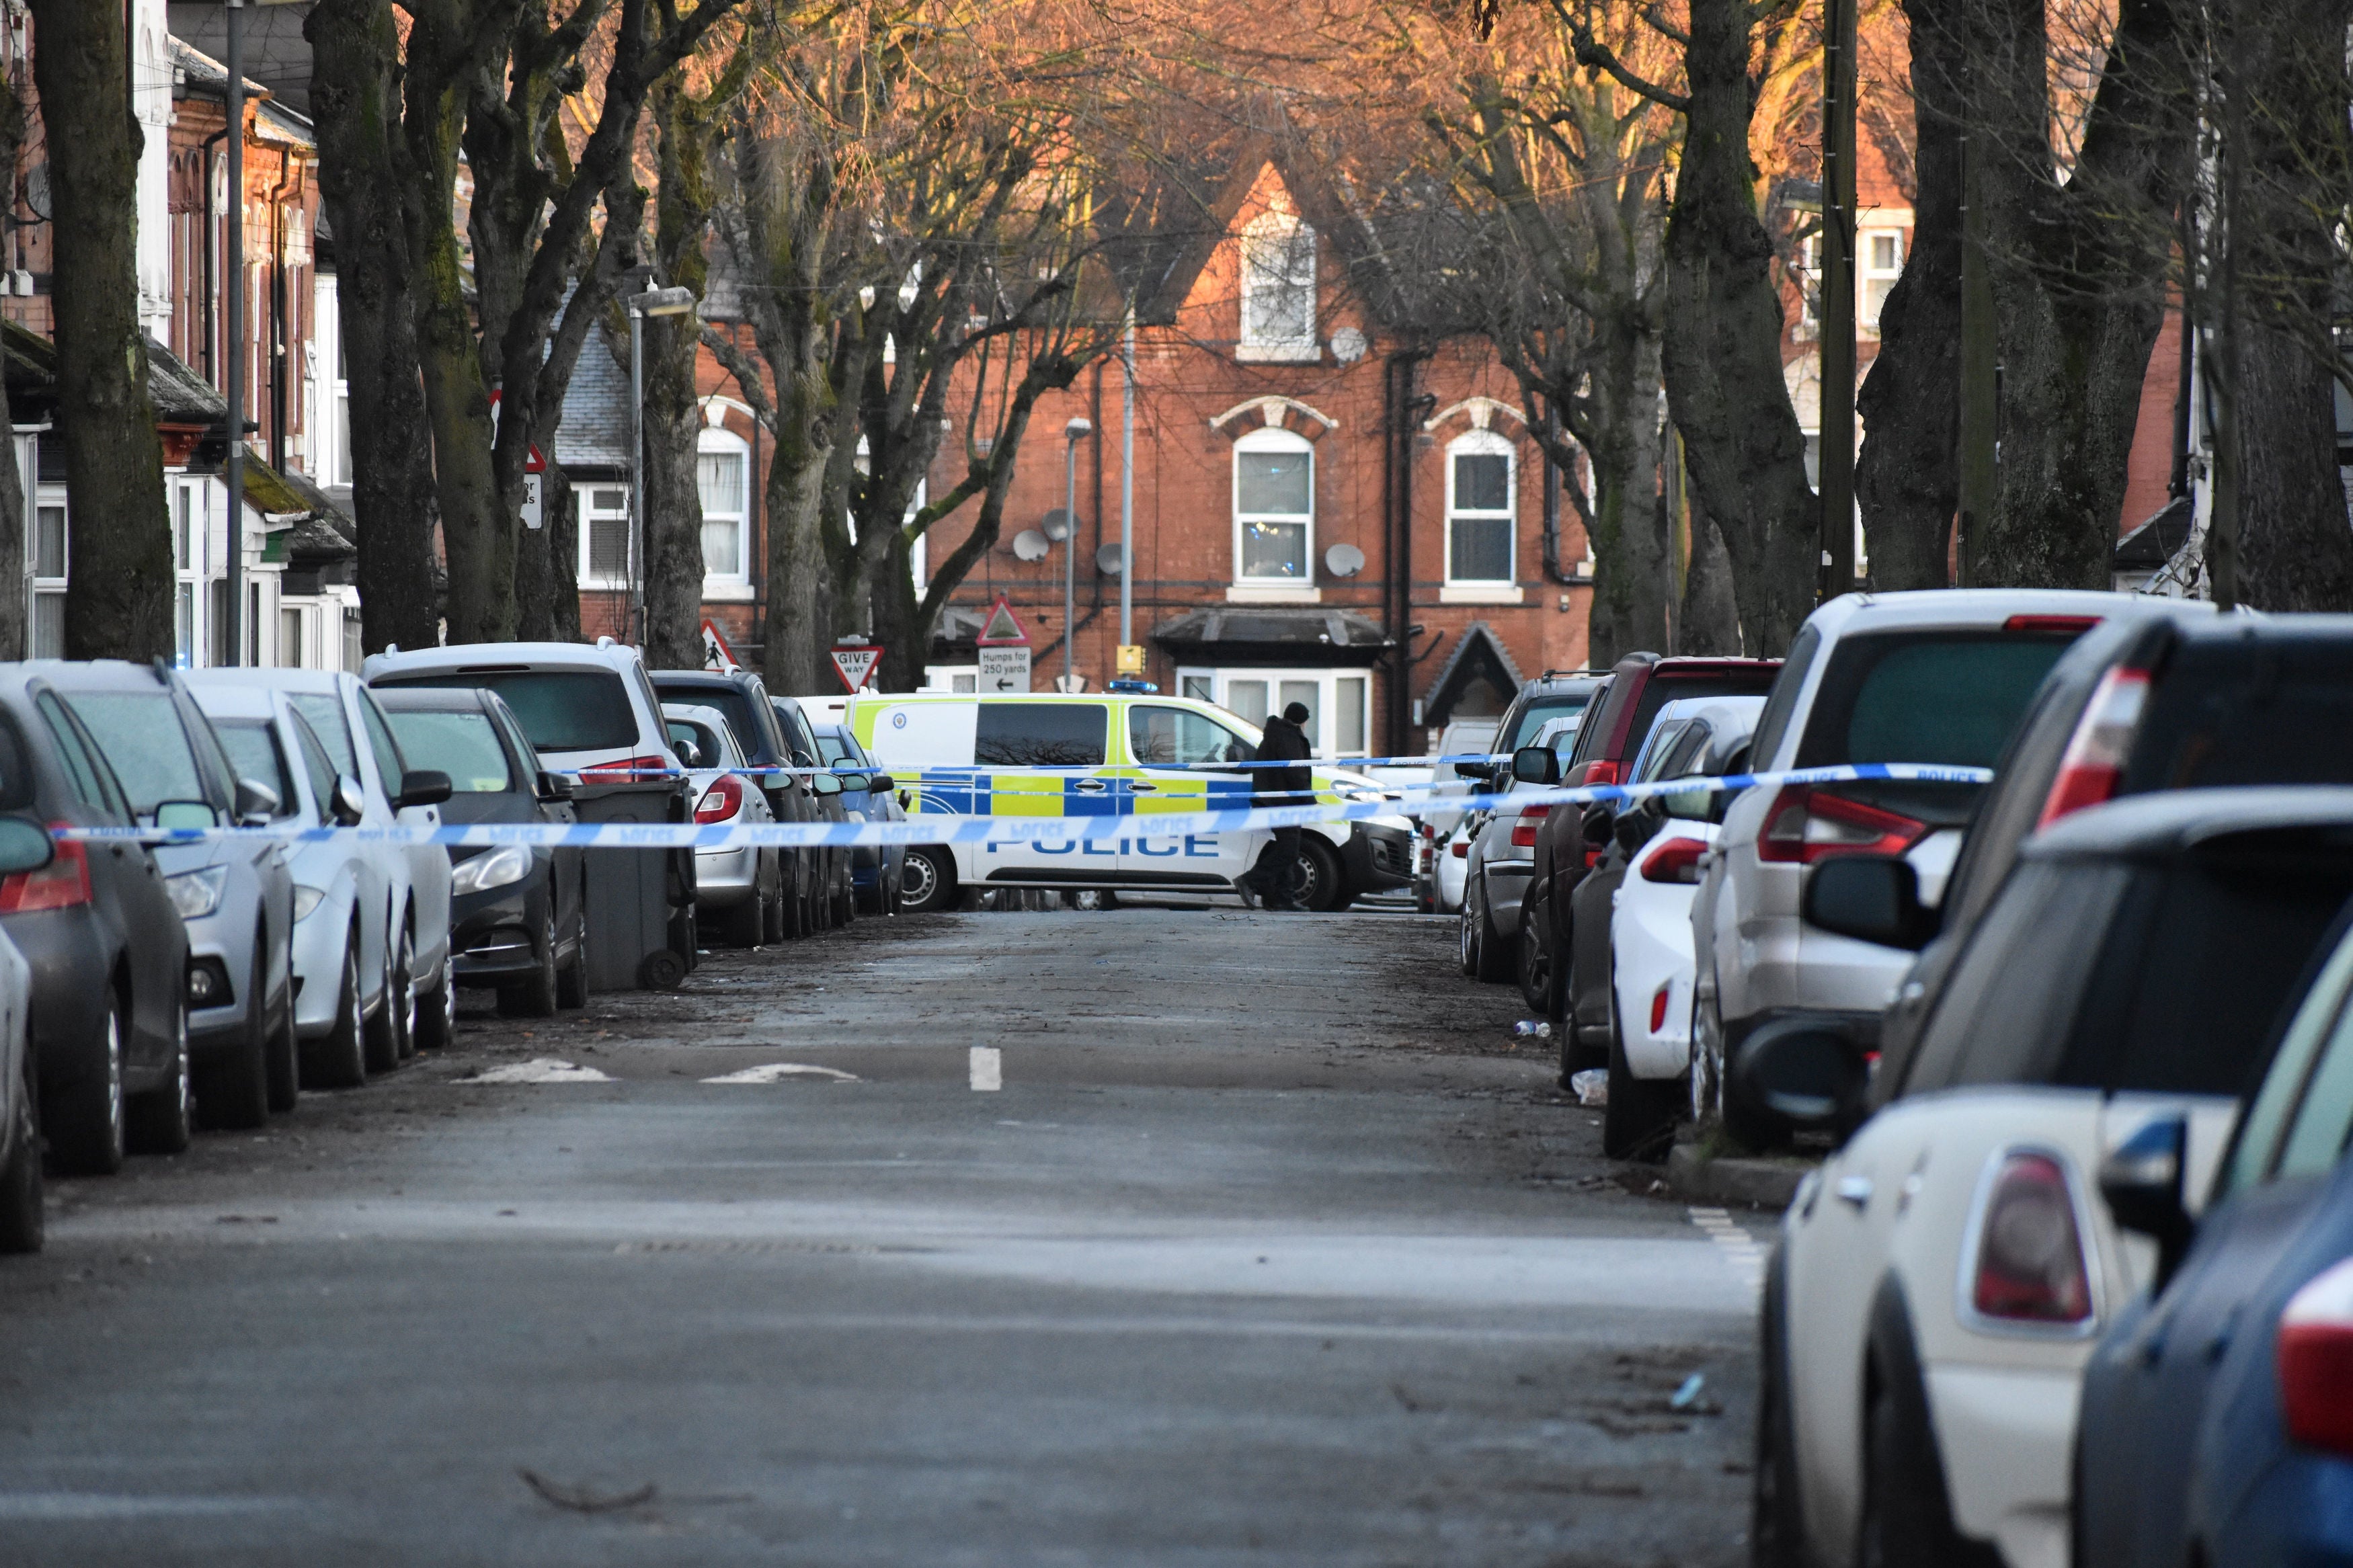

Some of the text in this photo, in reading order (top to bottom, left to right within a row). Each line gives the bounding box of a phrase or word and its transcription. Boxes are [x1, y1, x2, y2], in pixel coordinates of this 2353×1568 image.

[838, 653, 869, 663] GIVE
[983, 652, 1027, 663] Humps for
[984, 663, 1027, 675] 250 yards
[1917, 770, 1977, 783] POLICE
